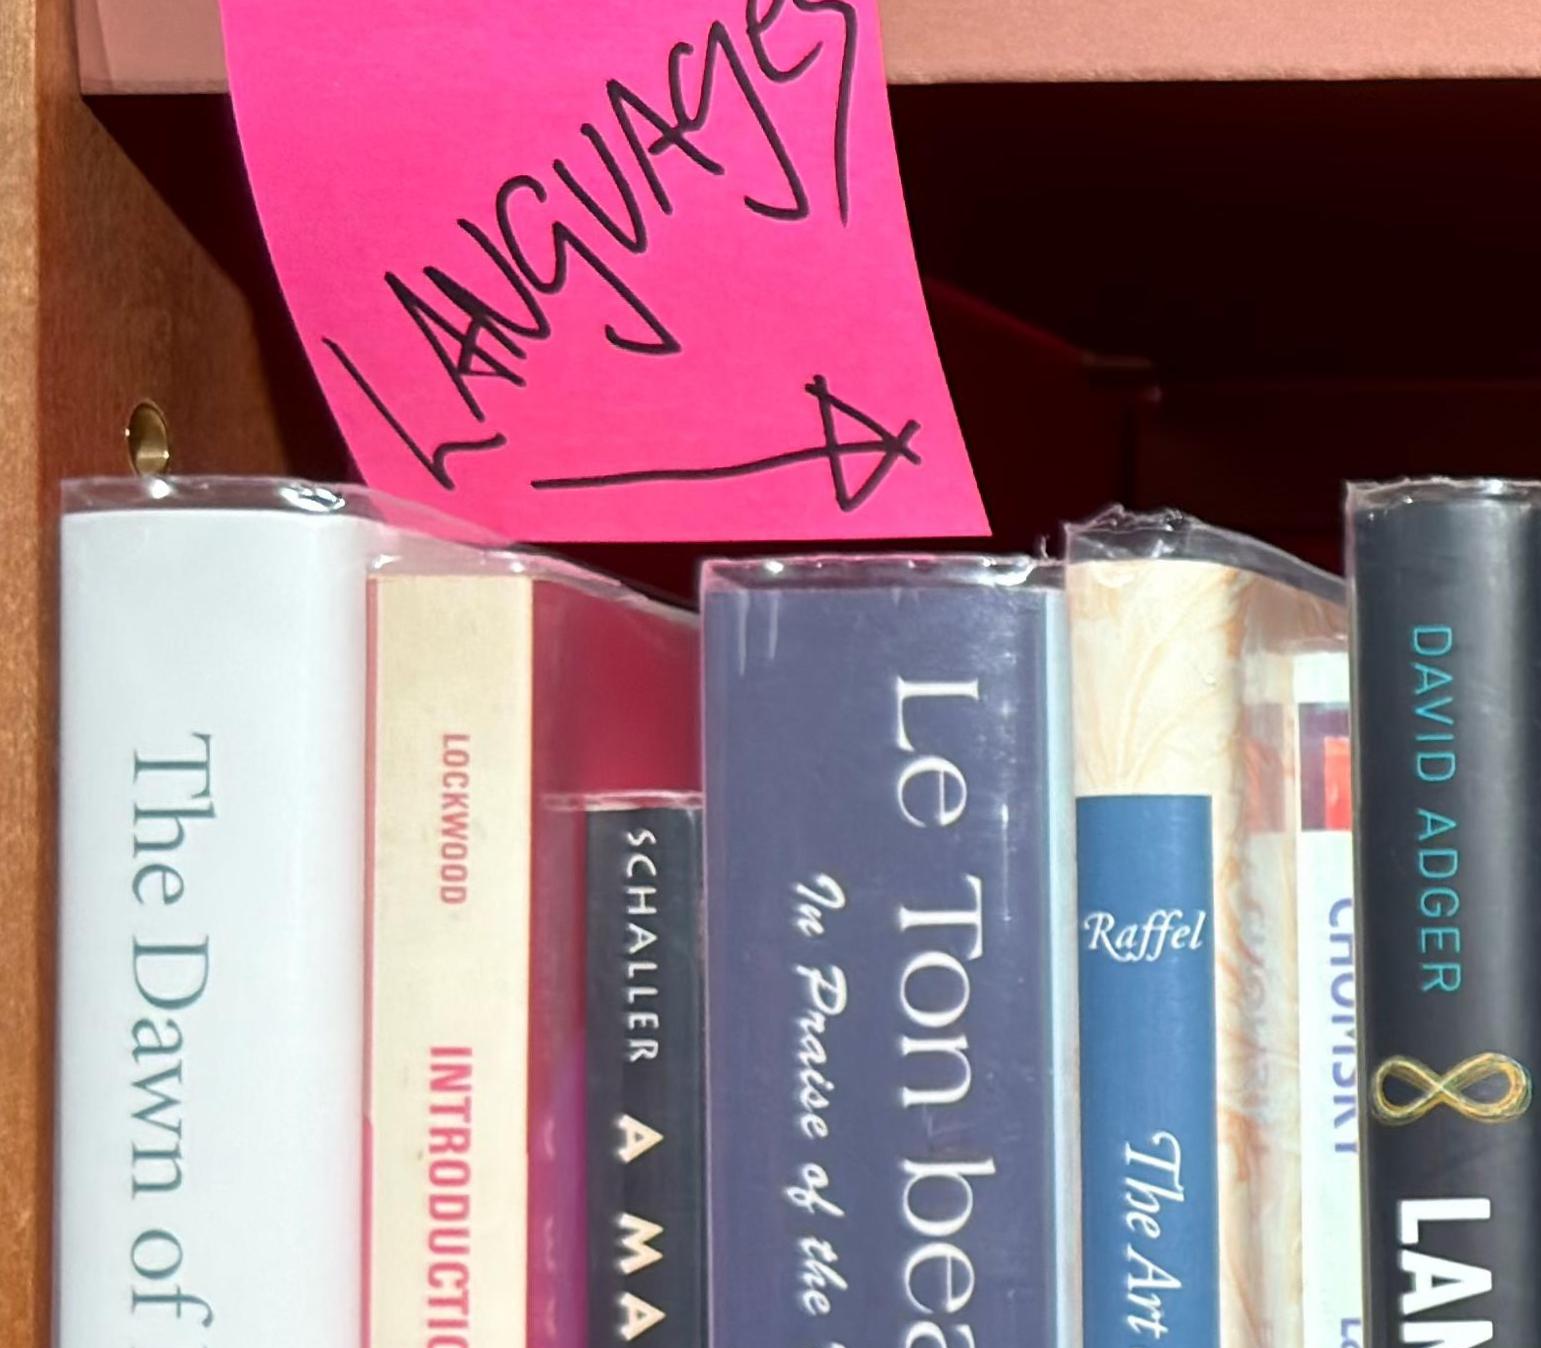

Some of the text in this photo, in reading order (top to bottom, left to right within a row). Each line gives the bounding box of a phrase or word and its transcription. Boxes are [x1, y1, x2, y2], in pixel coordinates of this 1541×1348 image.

[898, 677, 979, 828] Le
[1413, 624, 1462, 993] DAVID ADGER
[131, 731, 217, 907] The
[440, 732, 471, 905] LOCKWOOD
[624, 829, 661, 1063] SCHALLER
[796, 873, 845, 936] In
[1083, 910, 1204, 963] Raffel
[796, 965, 847, 1138] Praise
[899, 874, 983, 1108] Ton
[131, 935, 210, 1201] Dawn
[617, 1113, 664, 1163] A
[784, 1163, 844, 1218] of
[1124, 1131, 1185, 1239] The
[130, 1228, 214, 1329] of
[799, 1236, 847, 1315] the
[1125, 1246, 1183, 1339] Art
